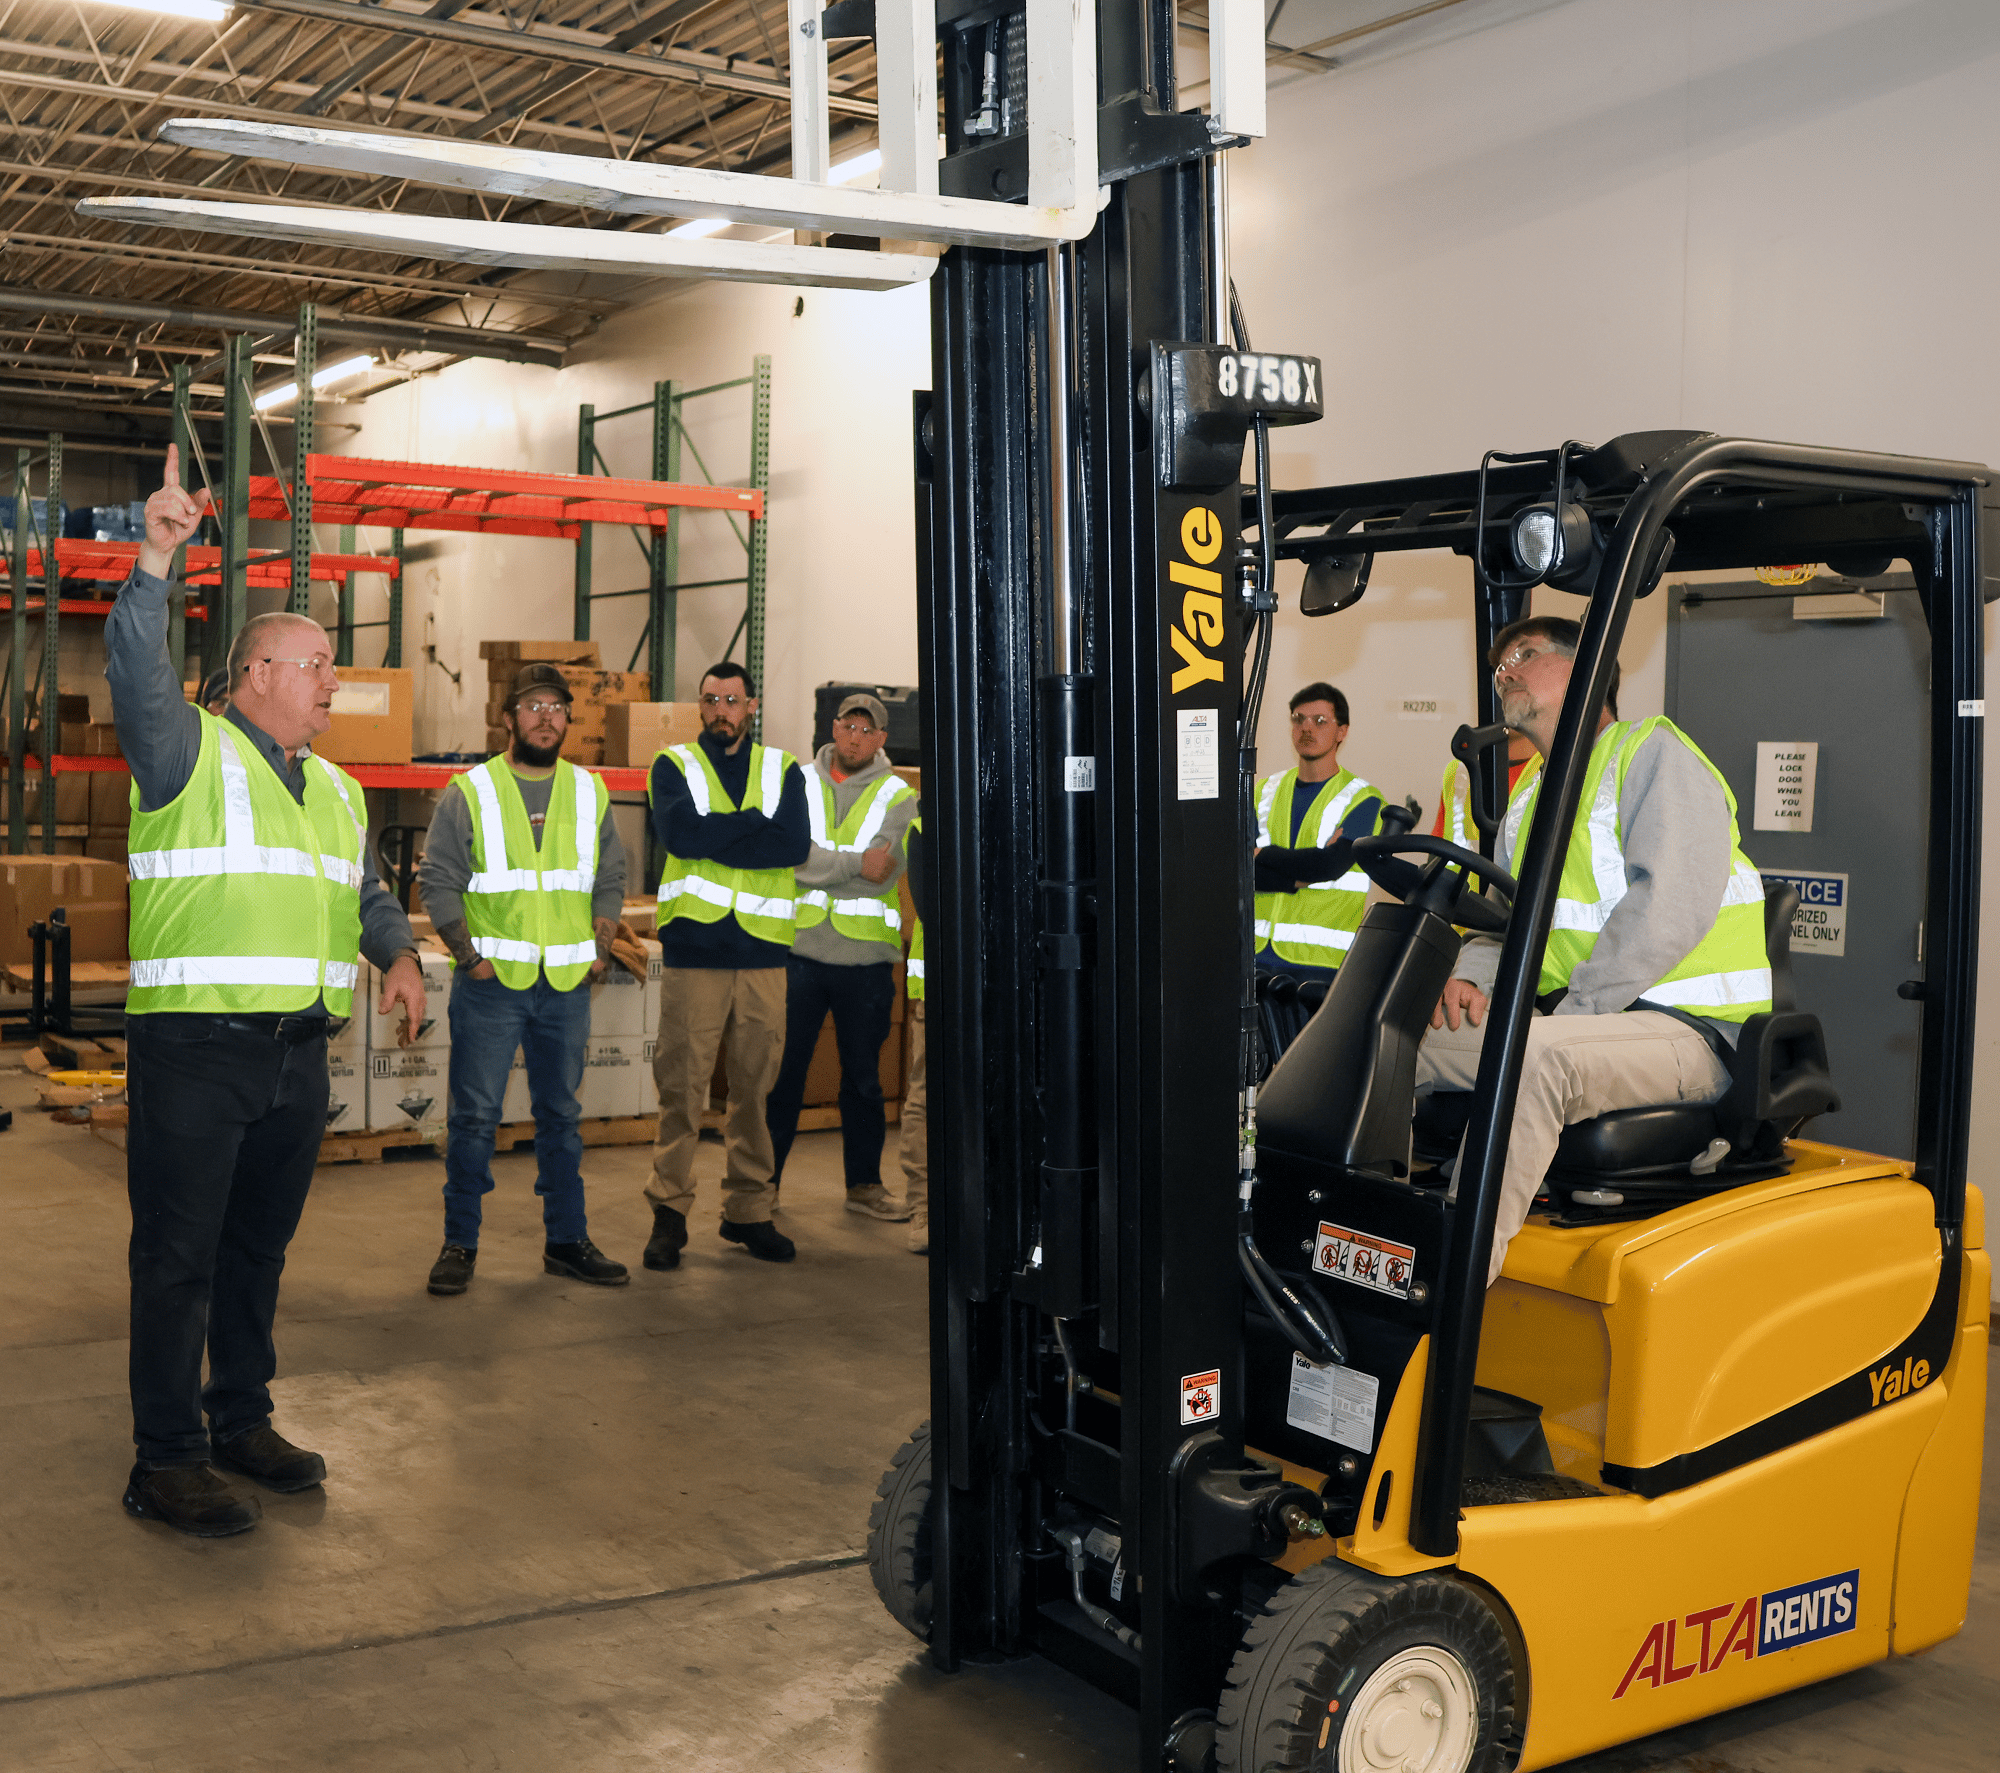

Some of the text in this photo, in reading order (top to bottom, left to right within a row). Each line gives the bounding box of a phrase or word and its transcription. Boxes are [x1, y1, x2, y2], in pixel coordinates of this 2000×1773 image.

[1218, 355, 1318, 404] 8758X
[1169, 506, 1224, 695] Yale
[1403, 701, 1437, 712] RK2730
[1774, 753, 1806, 761] PLEASE
[1774, 810, 1802, 818] LEAVE
[1791, 909, 1828, 924] ORIZED
[1812, 926, 1840, 941] ONLY
[1282, 1287, 1299, 1304] GATES
[1295, 1357, 1311, 1369] Yale
[1193, 1375, 1216, 1385] WARNING
[1869, 1356, 1930, 1408] Yale
[1610, 1581, 1853, 1701] ALTA RENTS
